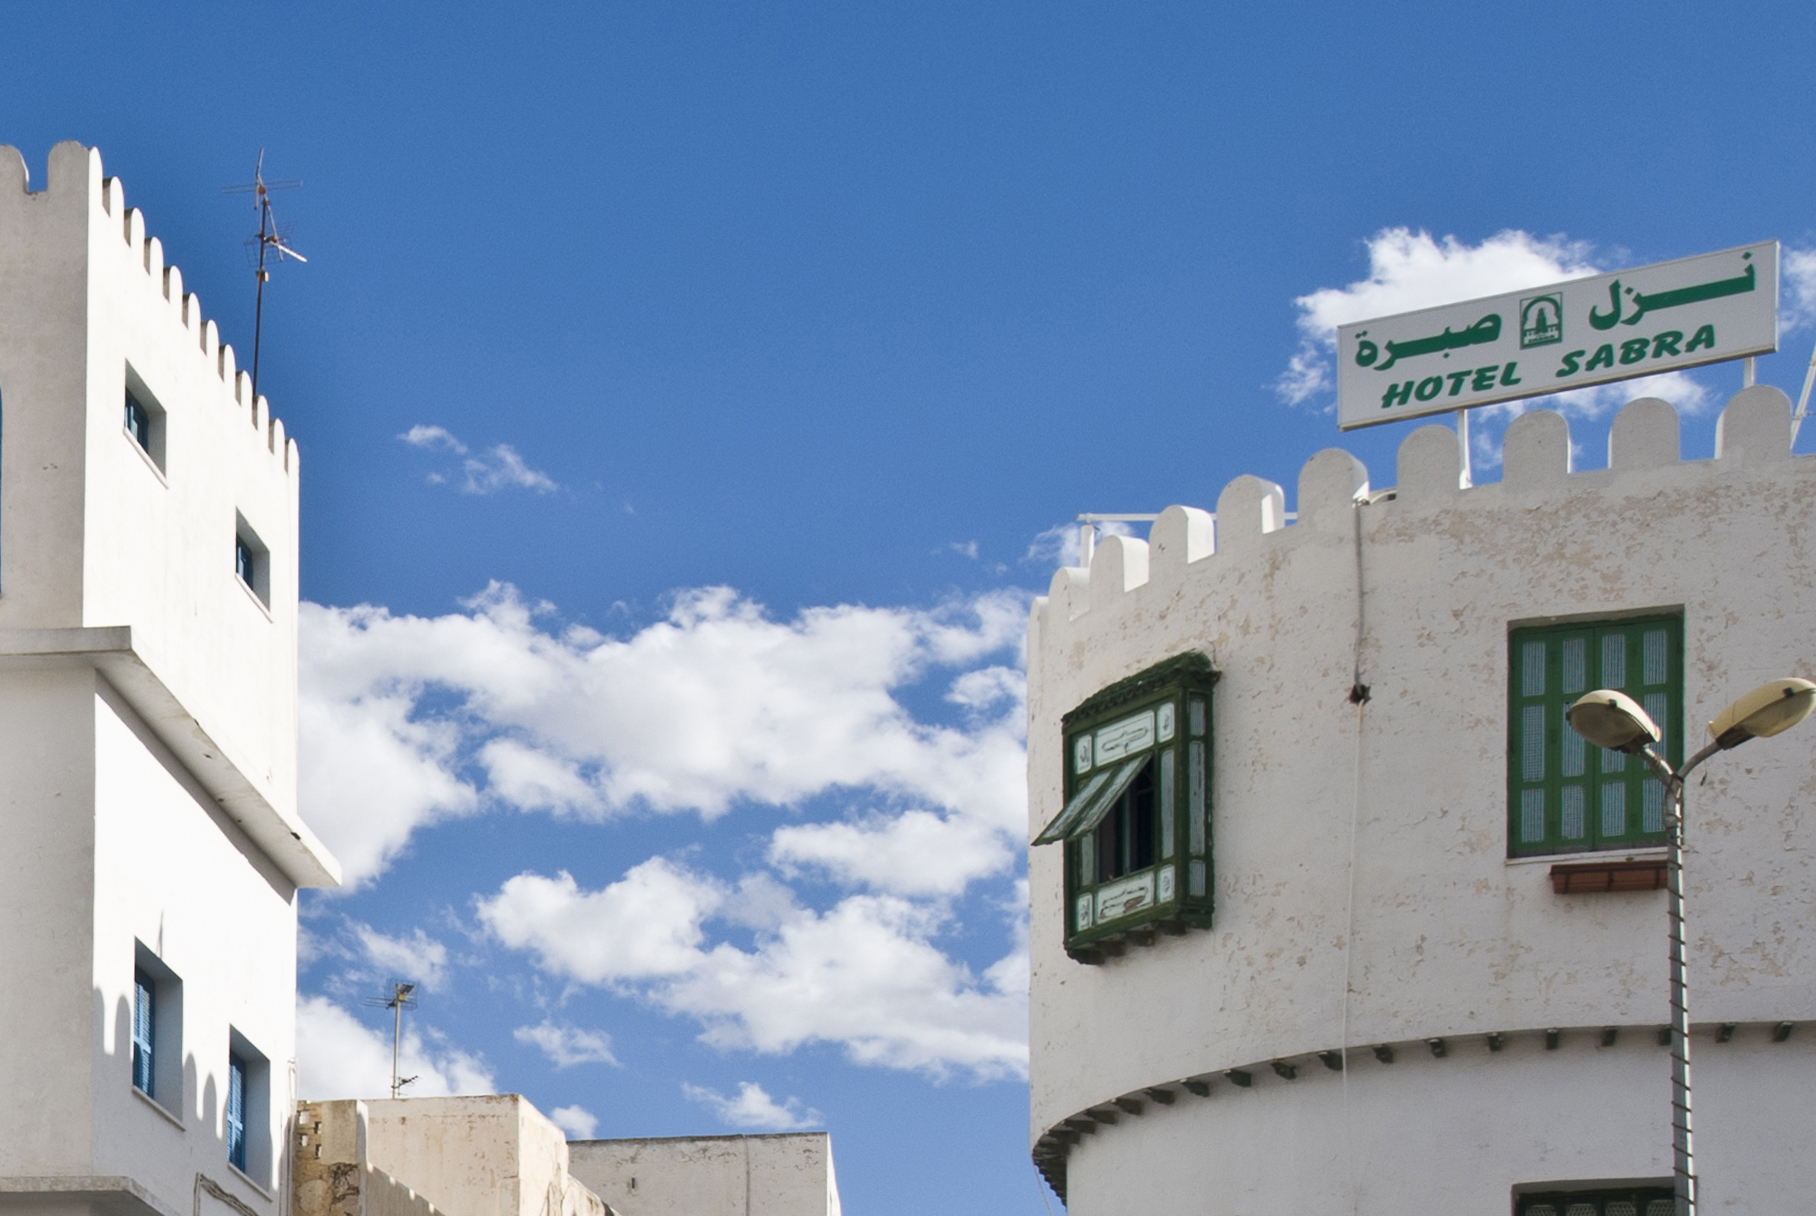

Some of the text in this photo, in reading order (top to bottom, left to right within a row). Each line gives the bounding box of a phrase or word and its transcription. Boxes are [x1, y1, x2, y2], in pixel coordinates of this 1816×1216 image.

[1355, 250, 1756, 371] نزل صبرة
[1381, 324, 1716, 409] HOTEL SABRA
